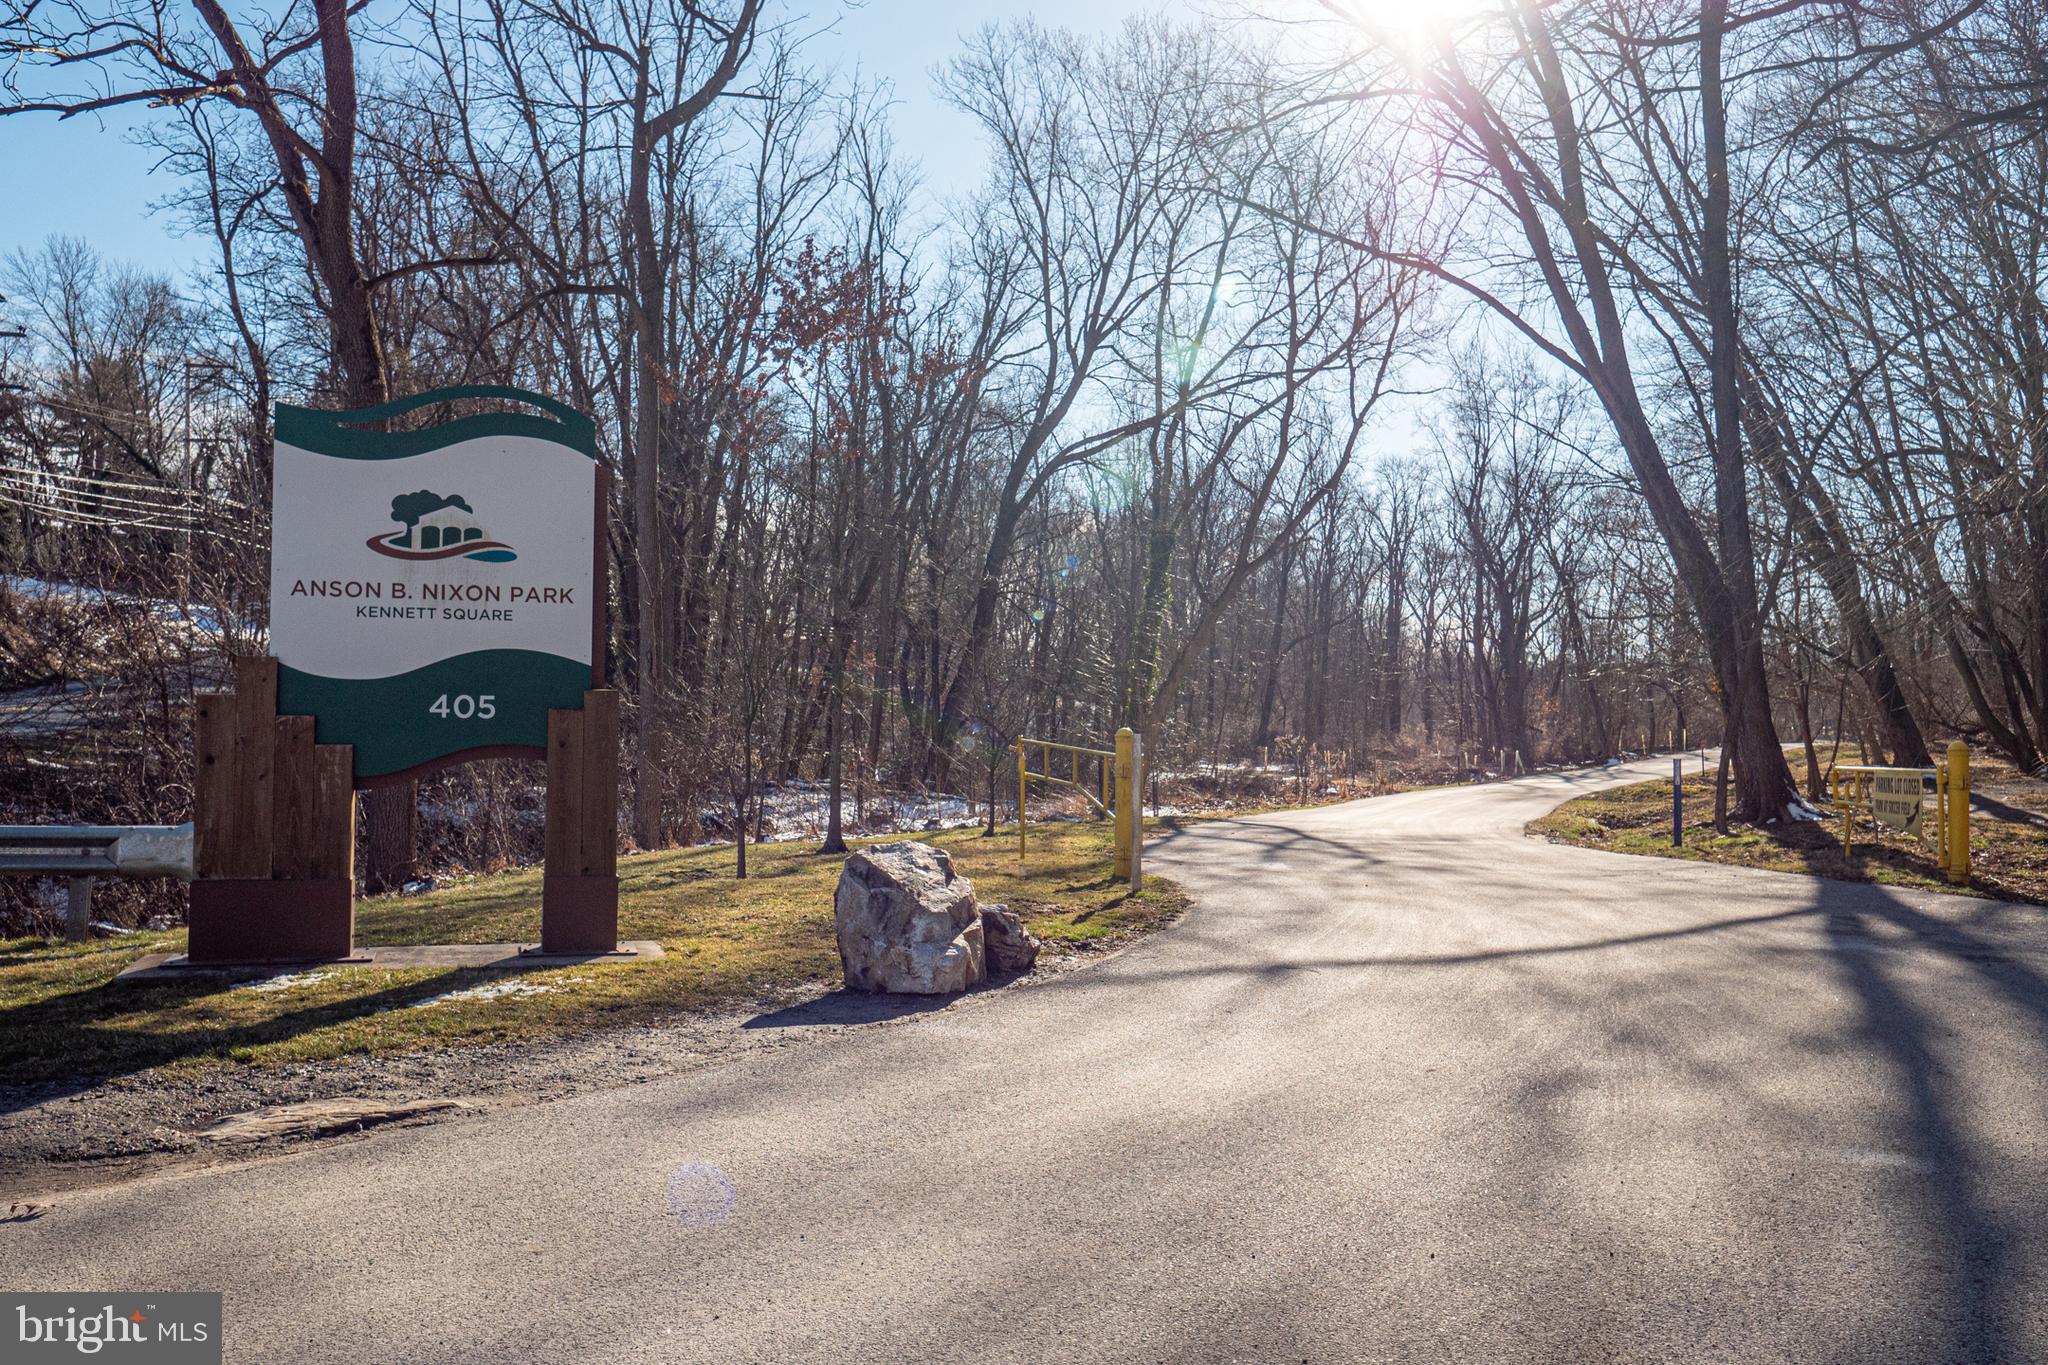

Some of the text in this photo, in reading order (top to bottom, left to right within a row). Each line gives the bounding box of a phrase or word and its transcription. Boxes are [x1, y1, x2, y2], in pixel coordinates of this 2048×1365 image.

[290, 579, 574, 604] ANSON B. NIXON PARK
[356, 605, 513, 622] KENNETT SQUARE
[429, 693, 496, 719] 405
